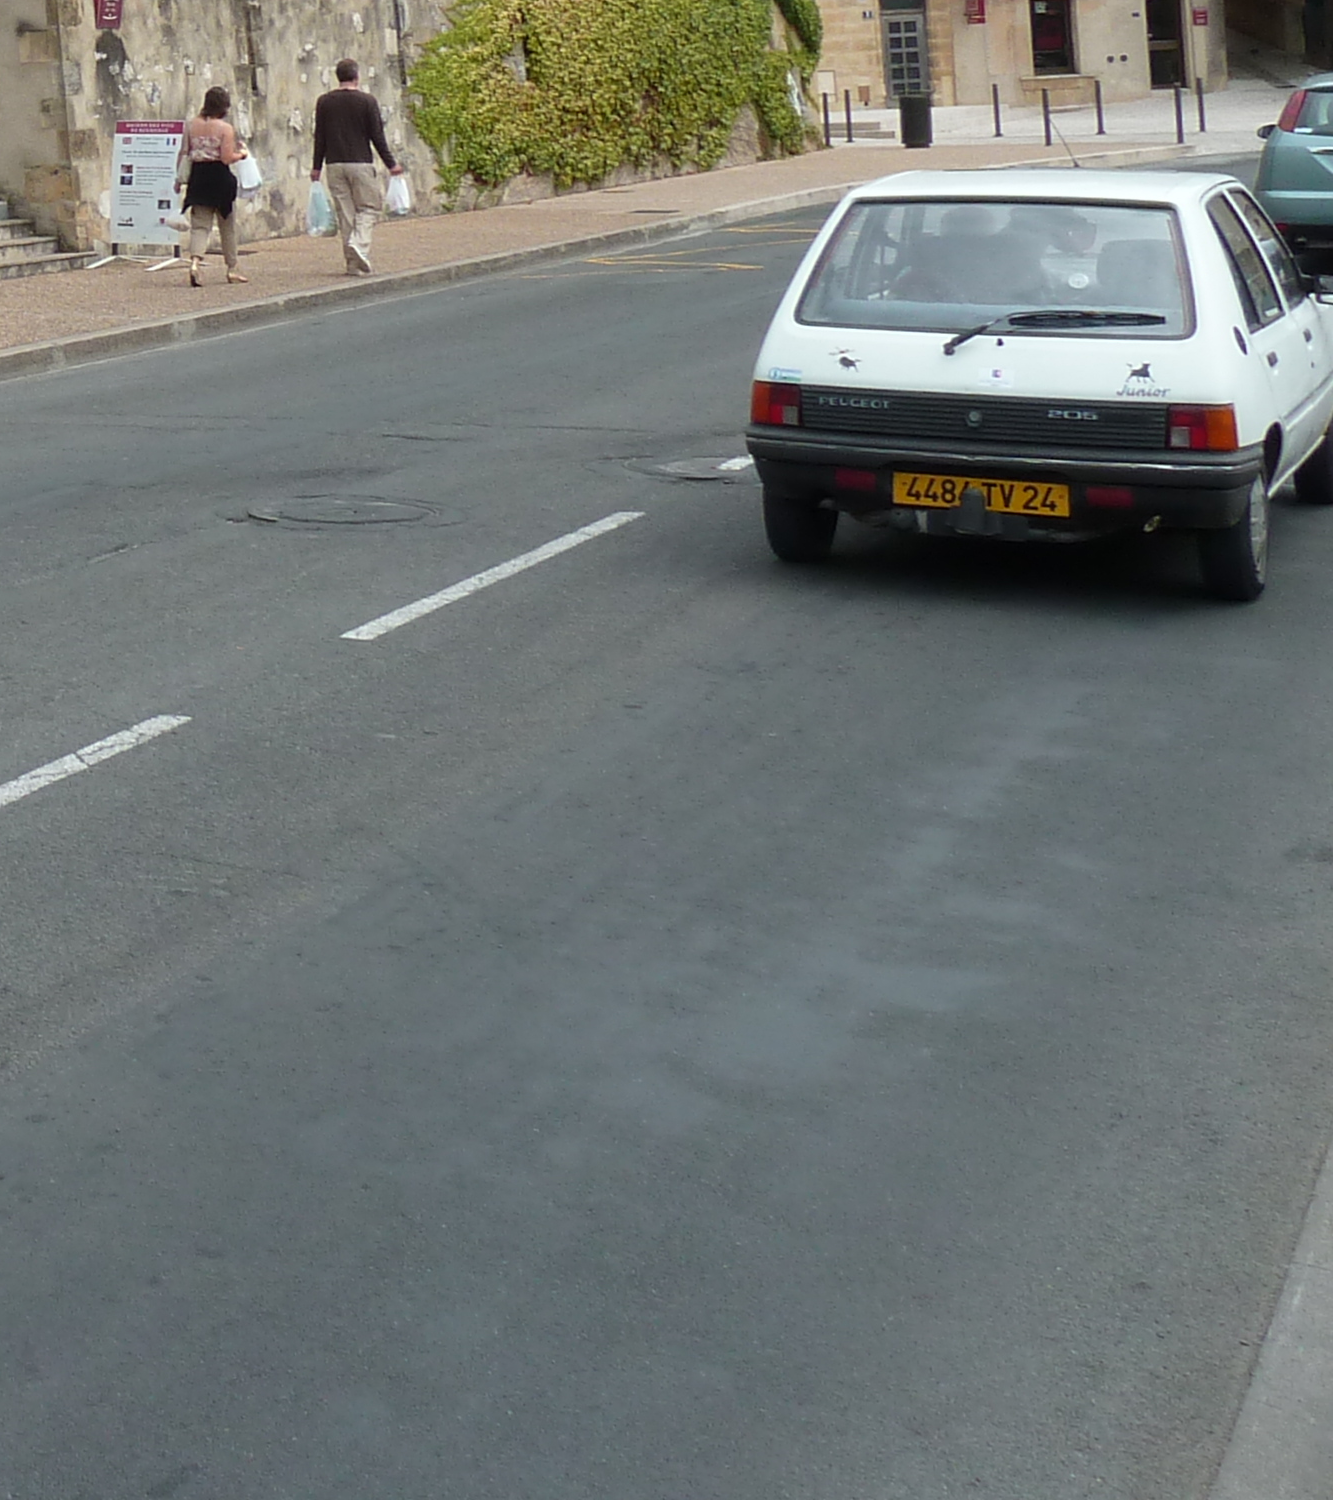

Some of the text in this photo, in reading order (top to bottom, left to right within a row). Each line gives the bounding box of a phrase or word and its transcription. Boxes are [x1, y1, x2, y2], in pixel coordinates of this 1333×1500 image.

[1116, 384, 1171, 398] Junior
[818, 396, 890, 409] PEUGEOT
[1047, 408, 1099, 421] 205
[981, 482, 1015, 508] TV
[1022, 485, 1058, 512] 24
